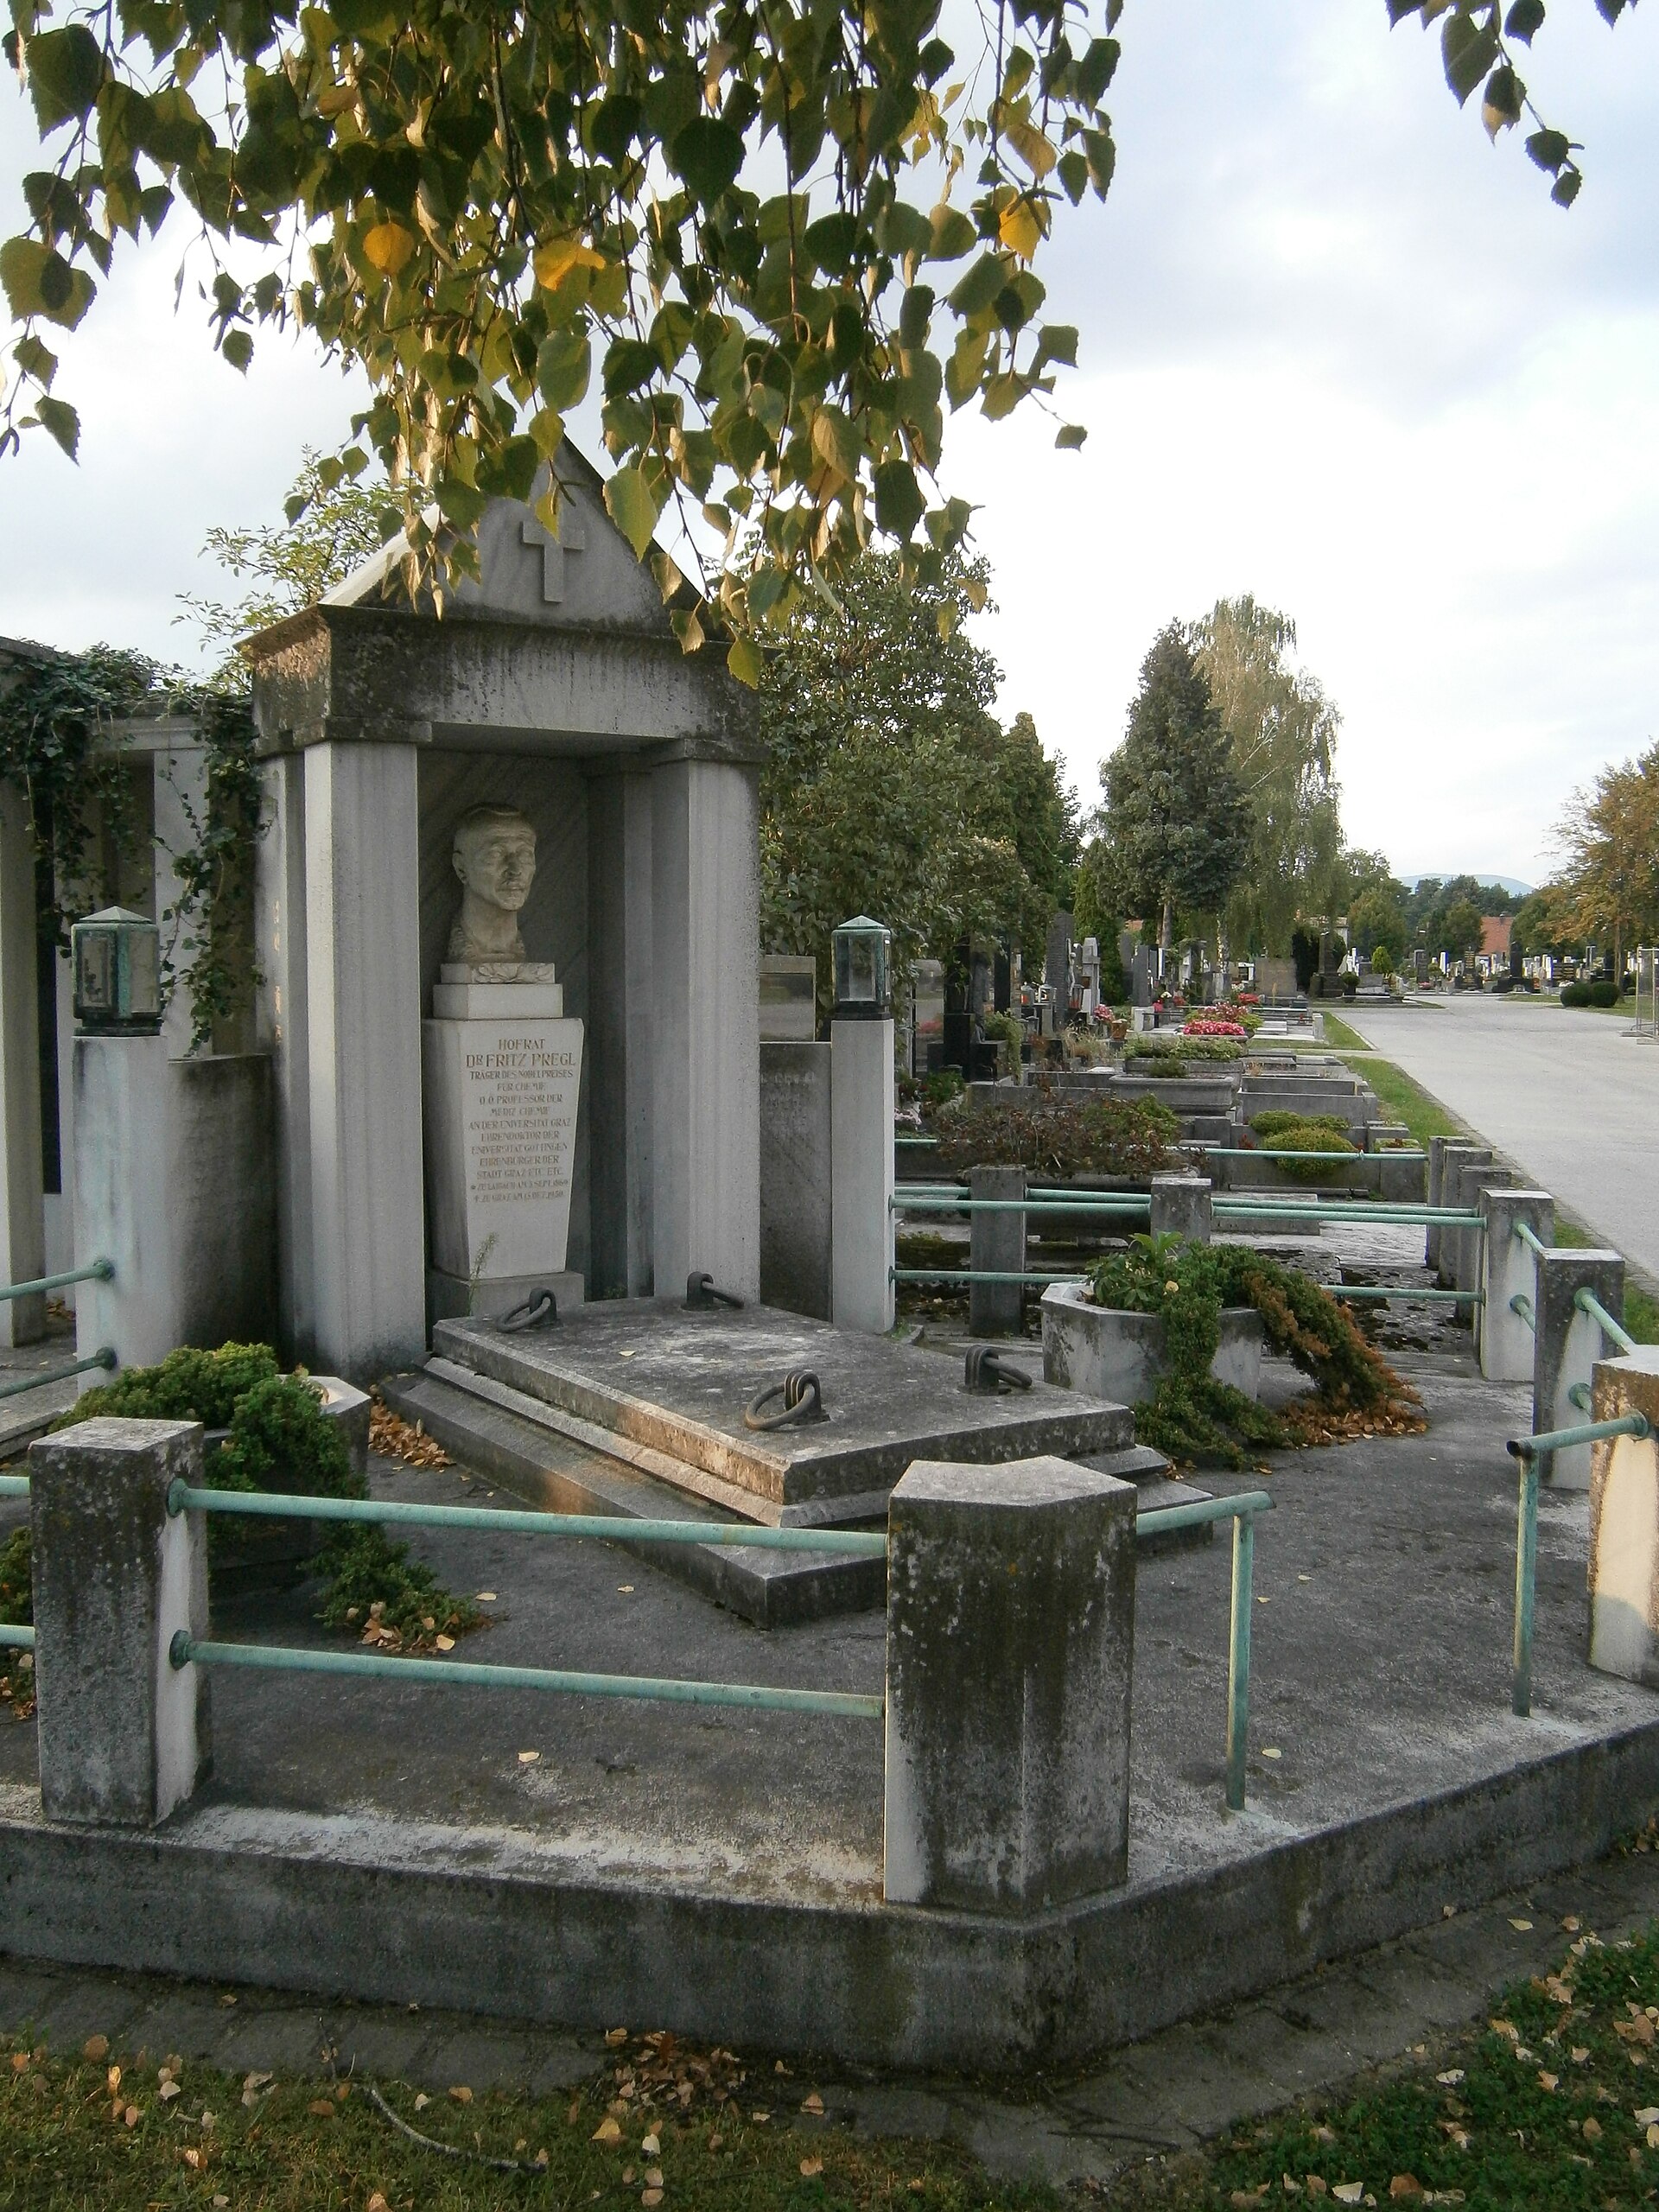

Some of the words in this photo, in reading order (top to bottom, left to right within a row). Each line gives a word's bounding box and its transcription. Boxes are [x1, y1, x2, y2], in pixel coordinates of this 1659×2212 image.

[499, 1039, 546, 1051] HOFRAT
[486, 1053, 526, 1067] FRITZ
[531, 1052, 575, 1066] PREGL
